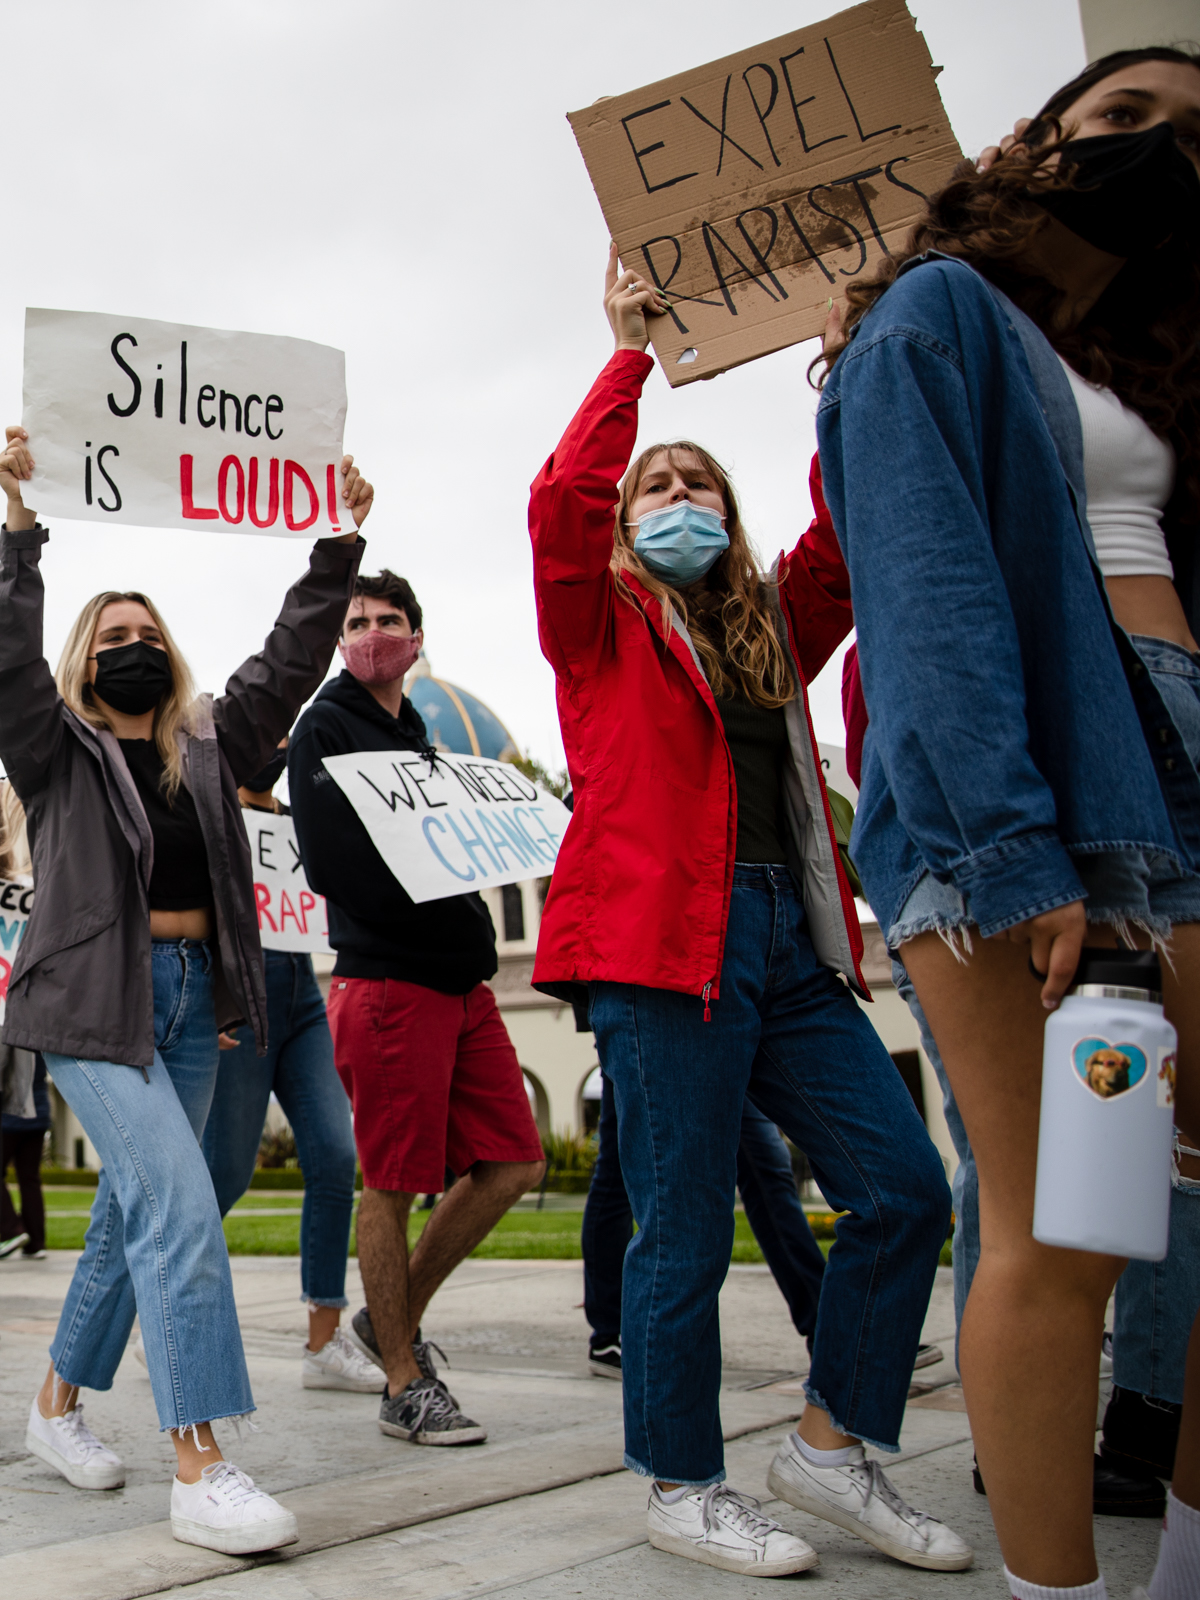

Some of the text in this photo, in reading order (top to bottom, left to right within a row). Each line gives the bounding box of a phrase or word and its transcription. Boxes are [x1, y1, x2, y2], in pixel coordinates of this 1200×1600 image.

[620, 36, 902, 194] EXPEL
[107, 332, 284, 440] Silence
[179, 453, 343, 533] LOUD!
[357, 761, 538, 813] WE NEED
